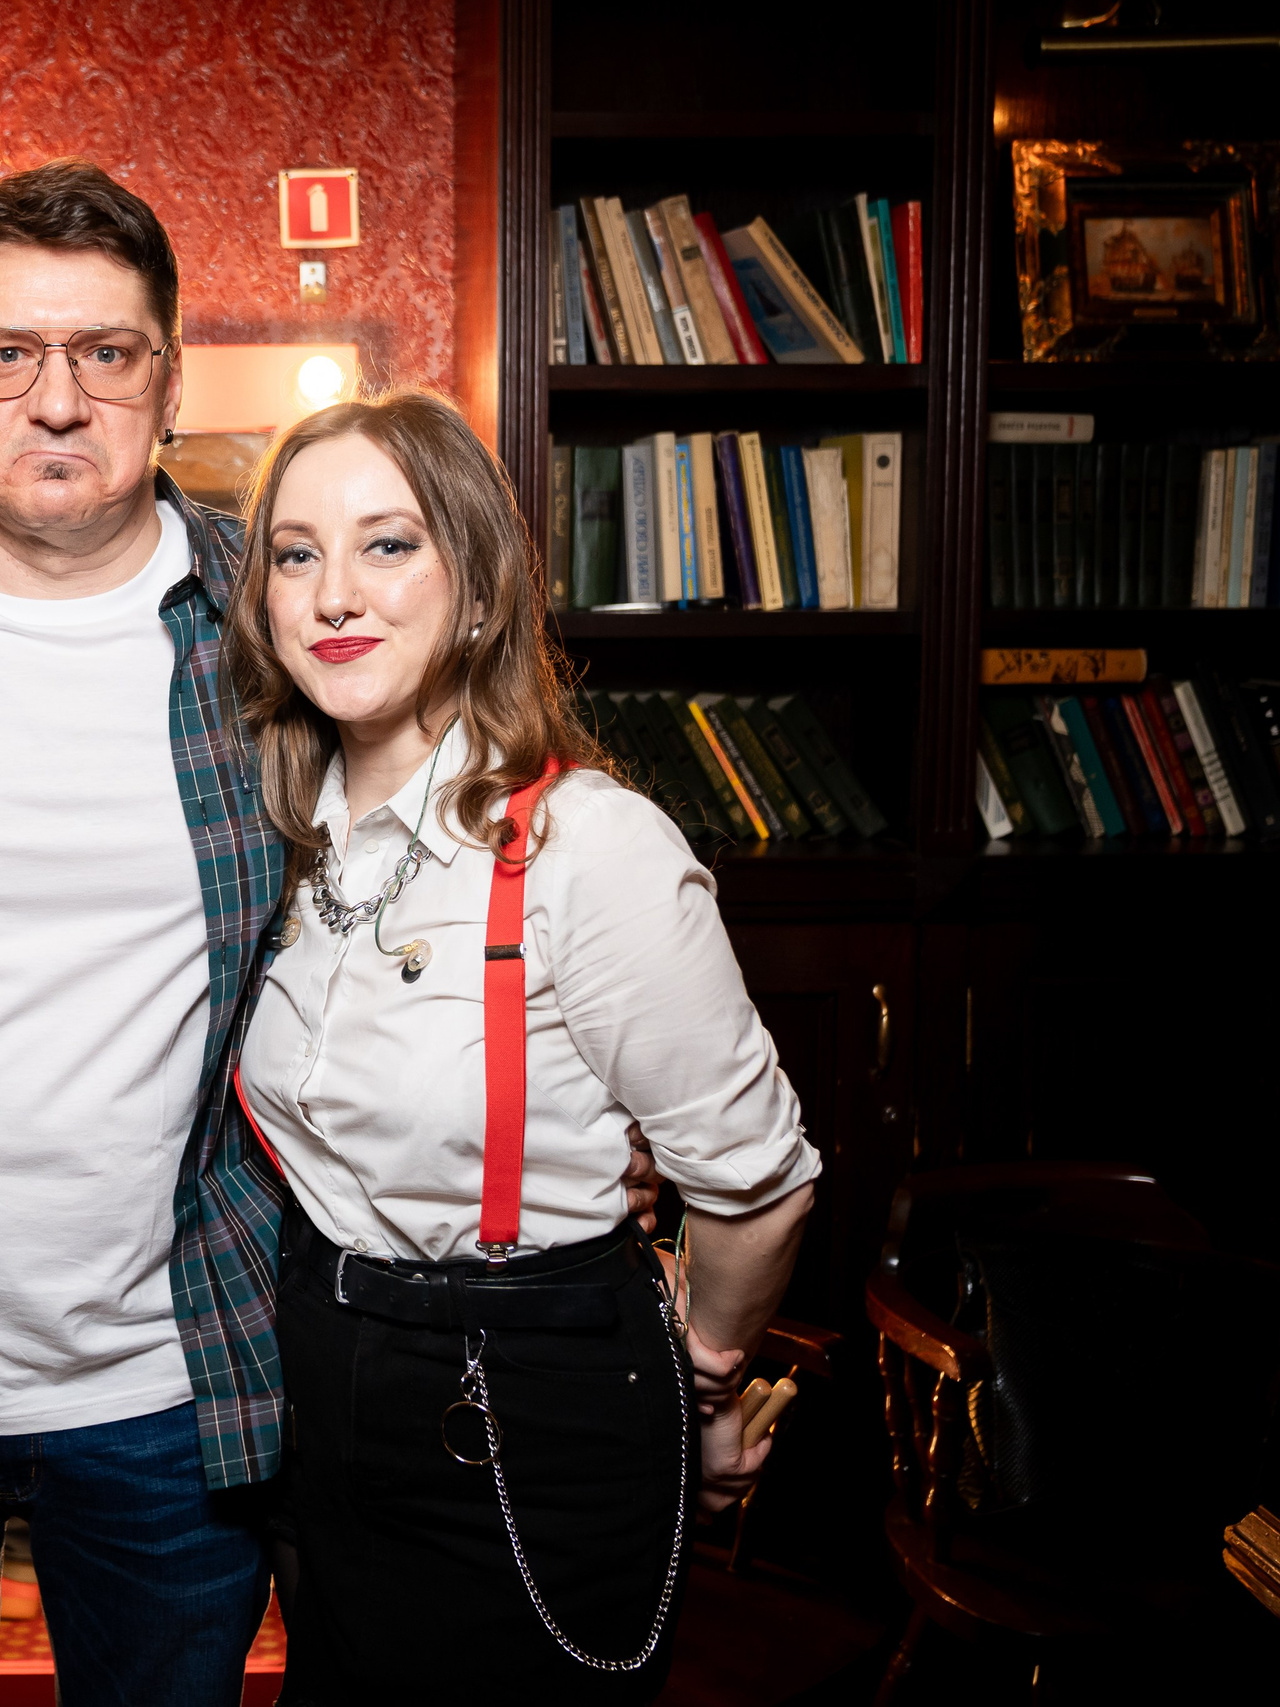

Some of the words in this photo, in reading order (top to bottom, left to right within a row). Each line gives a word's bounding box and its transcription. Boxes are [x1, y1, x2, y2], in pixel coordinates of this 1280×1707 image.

[632, 457, 646, 508] СУДЬБУ
[634, 509, 649, 552] СВОЮ
[637, 553, 651, 599] ТВОРИ
